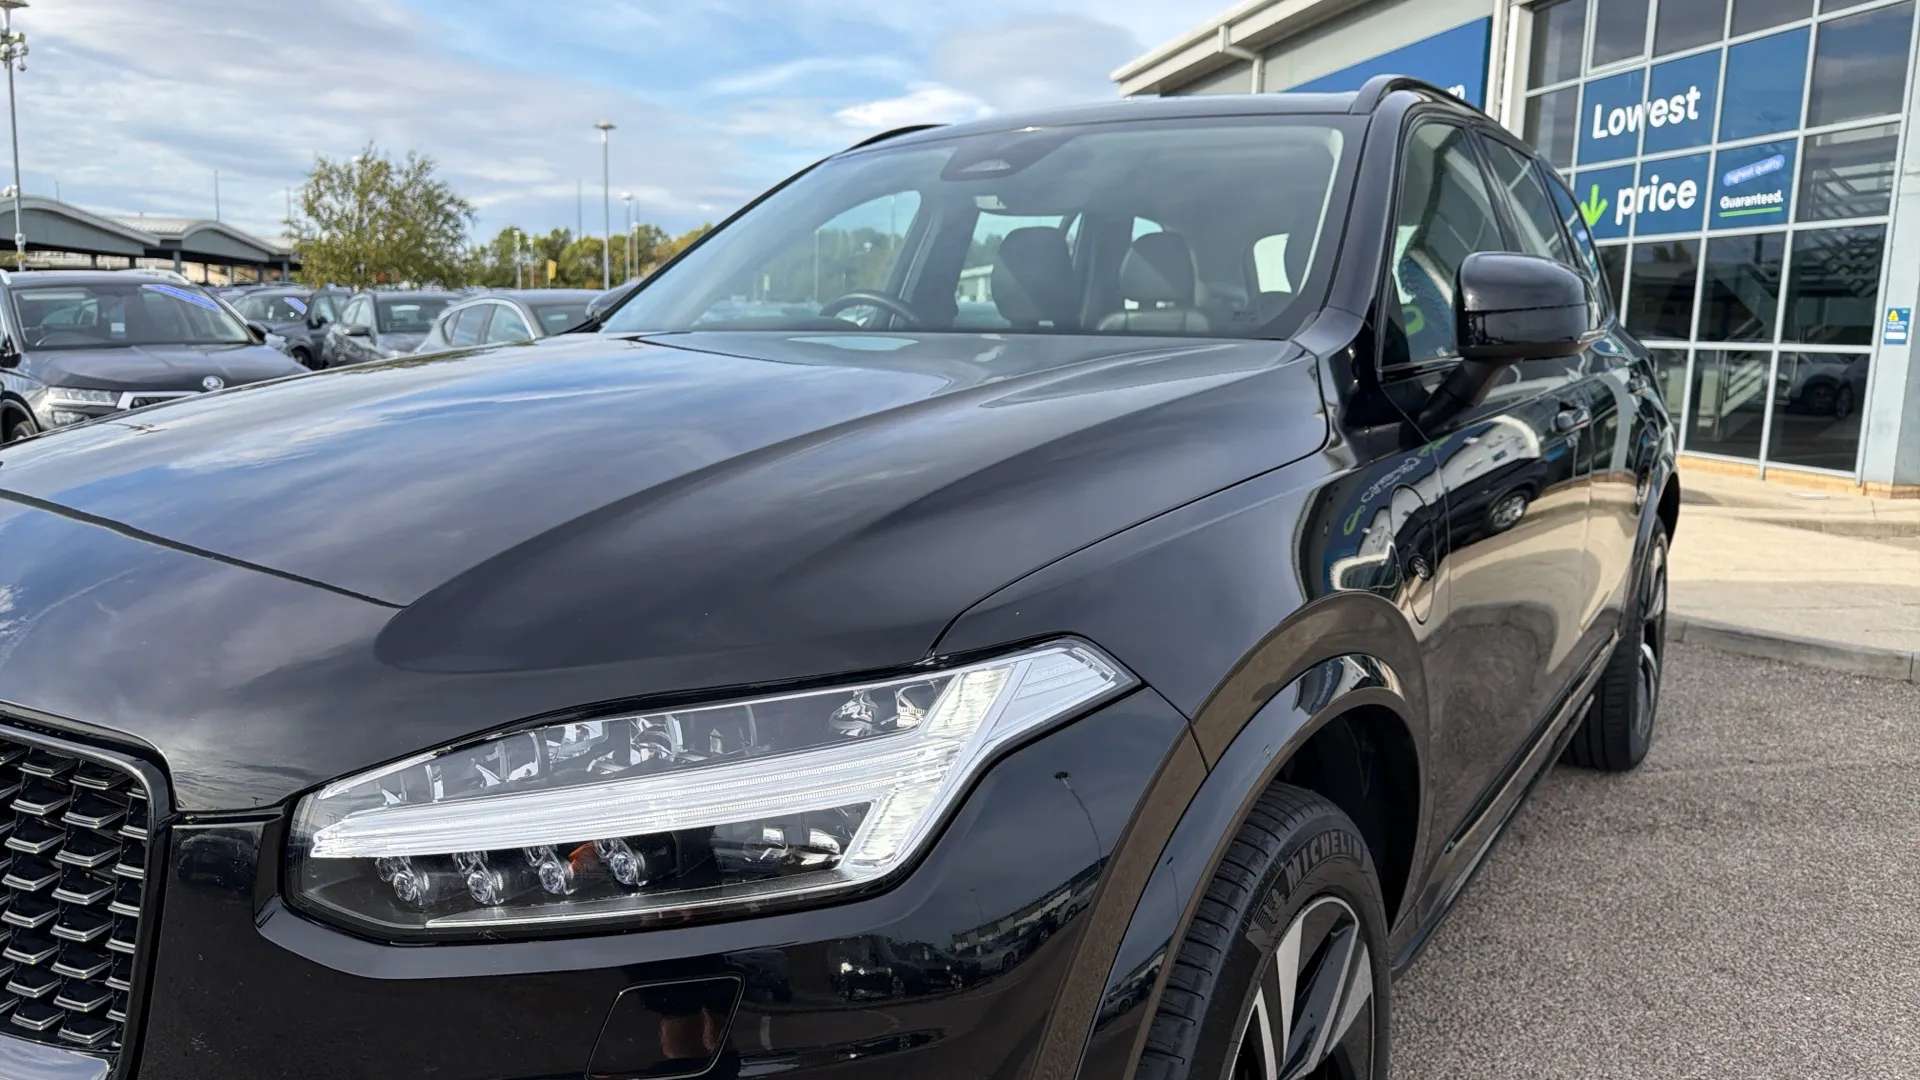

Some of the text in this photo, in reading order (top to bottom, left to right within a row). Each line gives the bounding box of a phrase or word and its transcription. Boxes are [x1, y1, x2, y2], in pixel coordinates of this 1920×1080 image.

[1592, 86, 1701, 139] Lowest
[1615, 174, 1697, 226] price
[1285, 830, 1362, 892] MICHELIN
